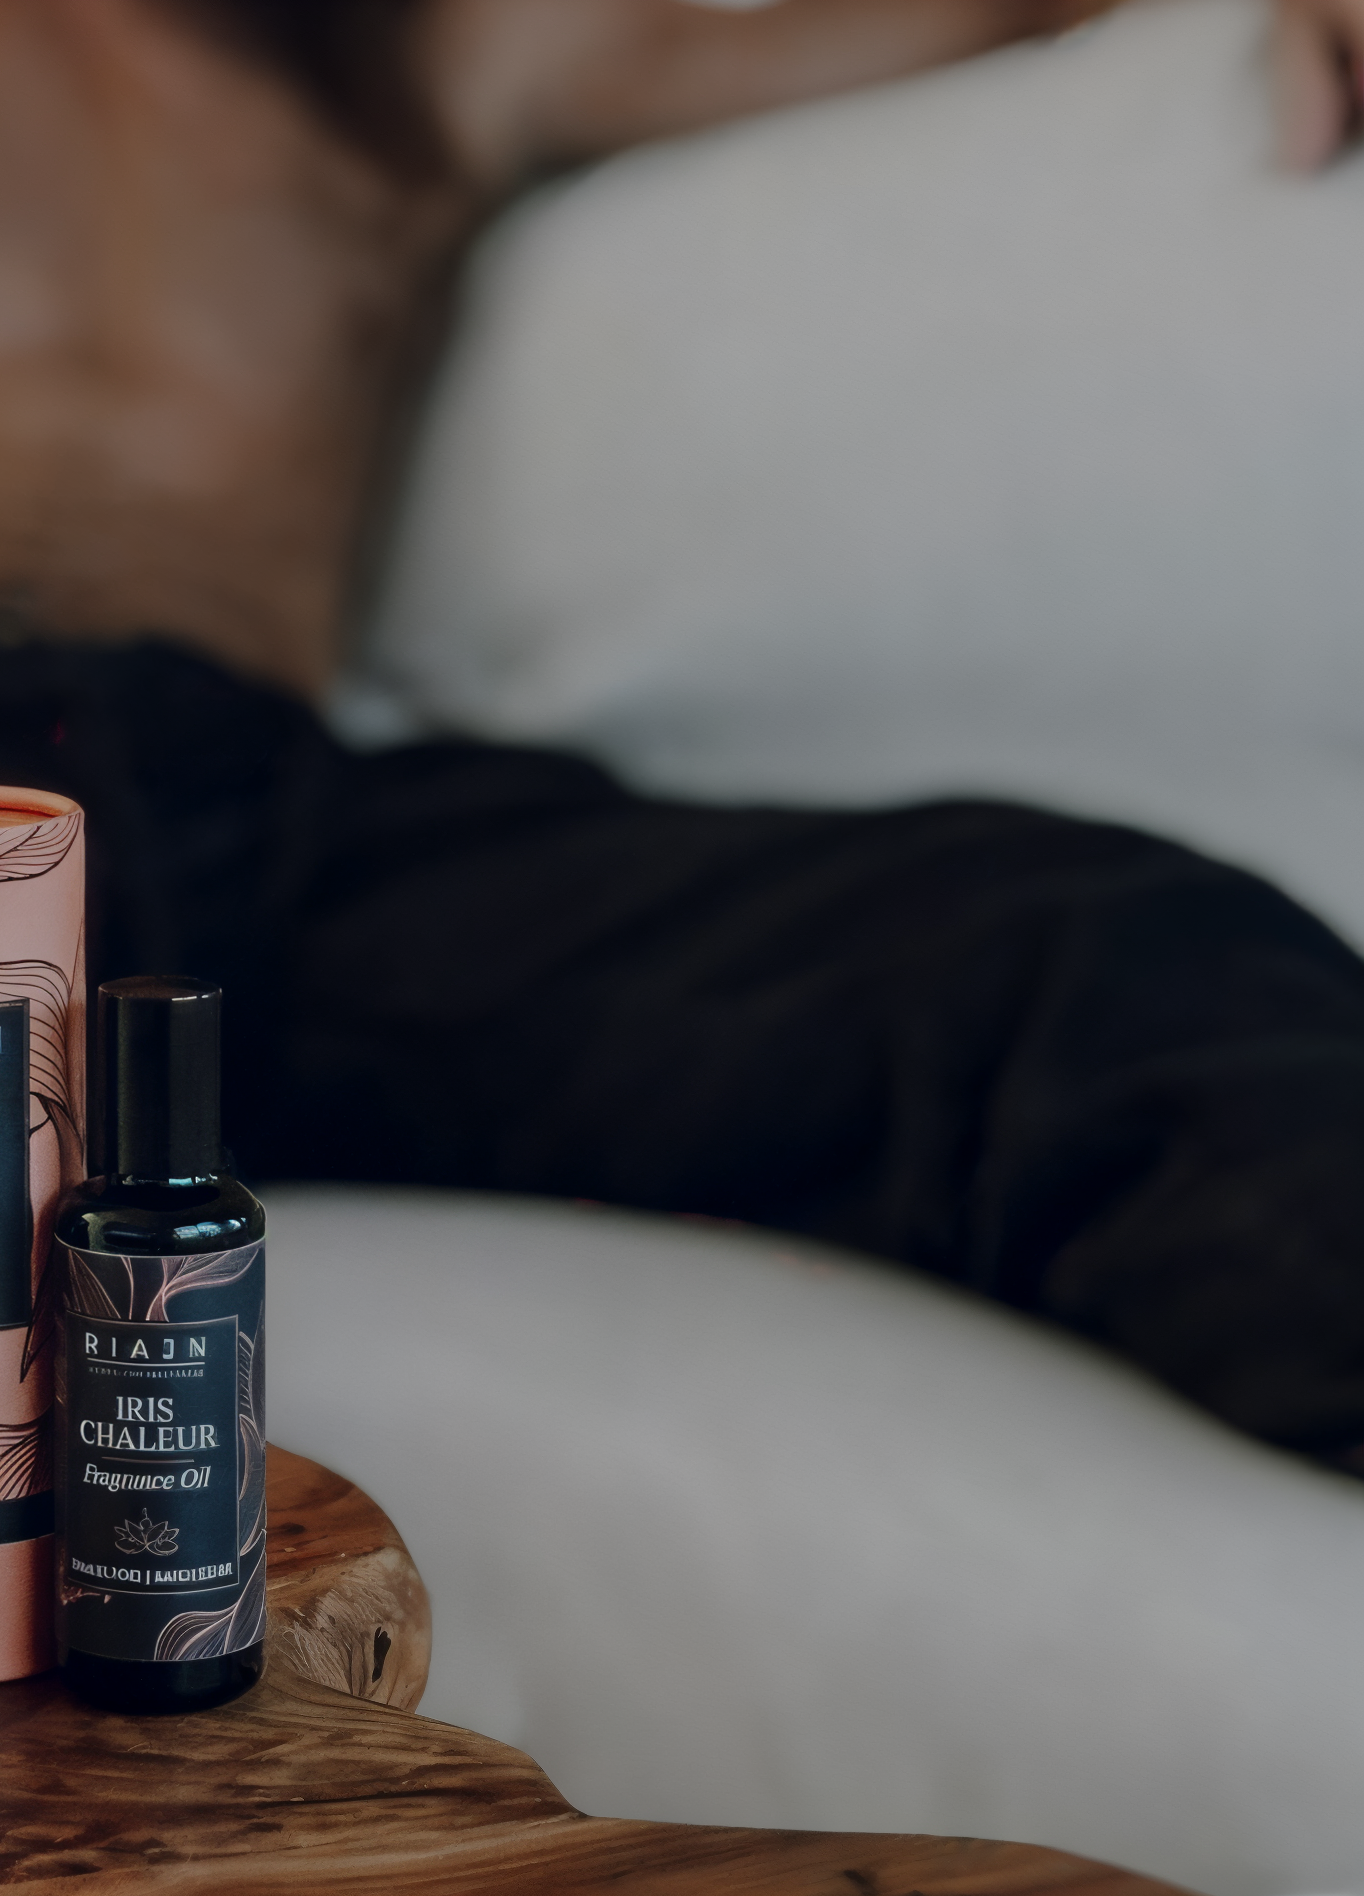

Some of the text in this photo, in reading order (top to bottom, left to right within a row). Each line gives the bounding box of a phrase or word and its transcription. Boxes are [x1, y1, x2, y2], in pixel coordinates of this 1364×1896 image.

[85, 1332, 207, 1360] RIAJN
[116, 1396, 174, 1423] IRIS
[80, 1419, 221, 1451] CHALEUR
